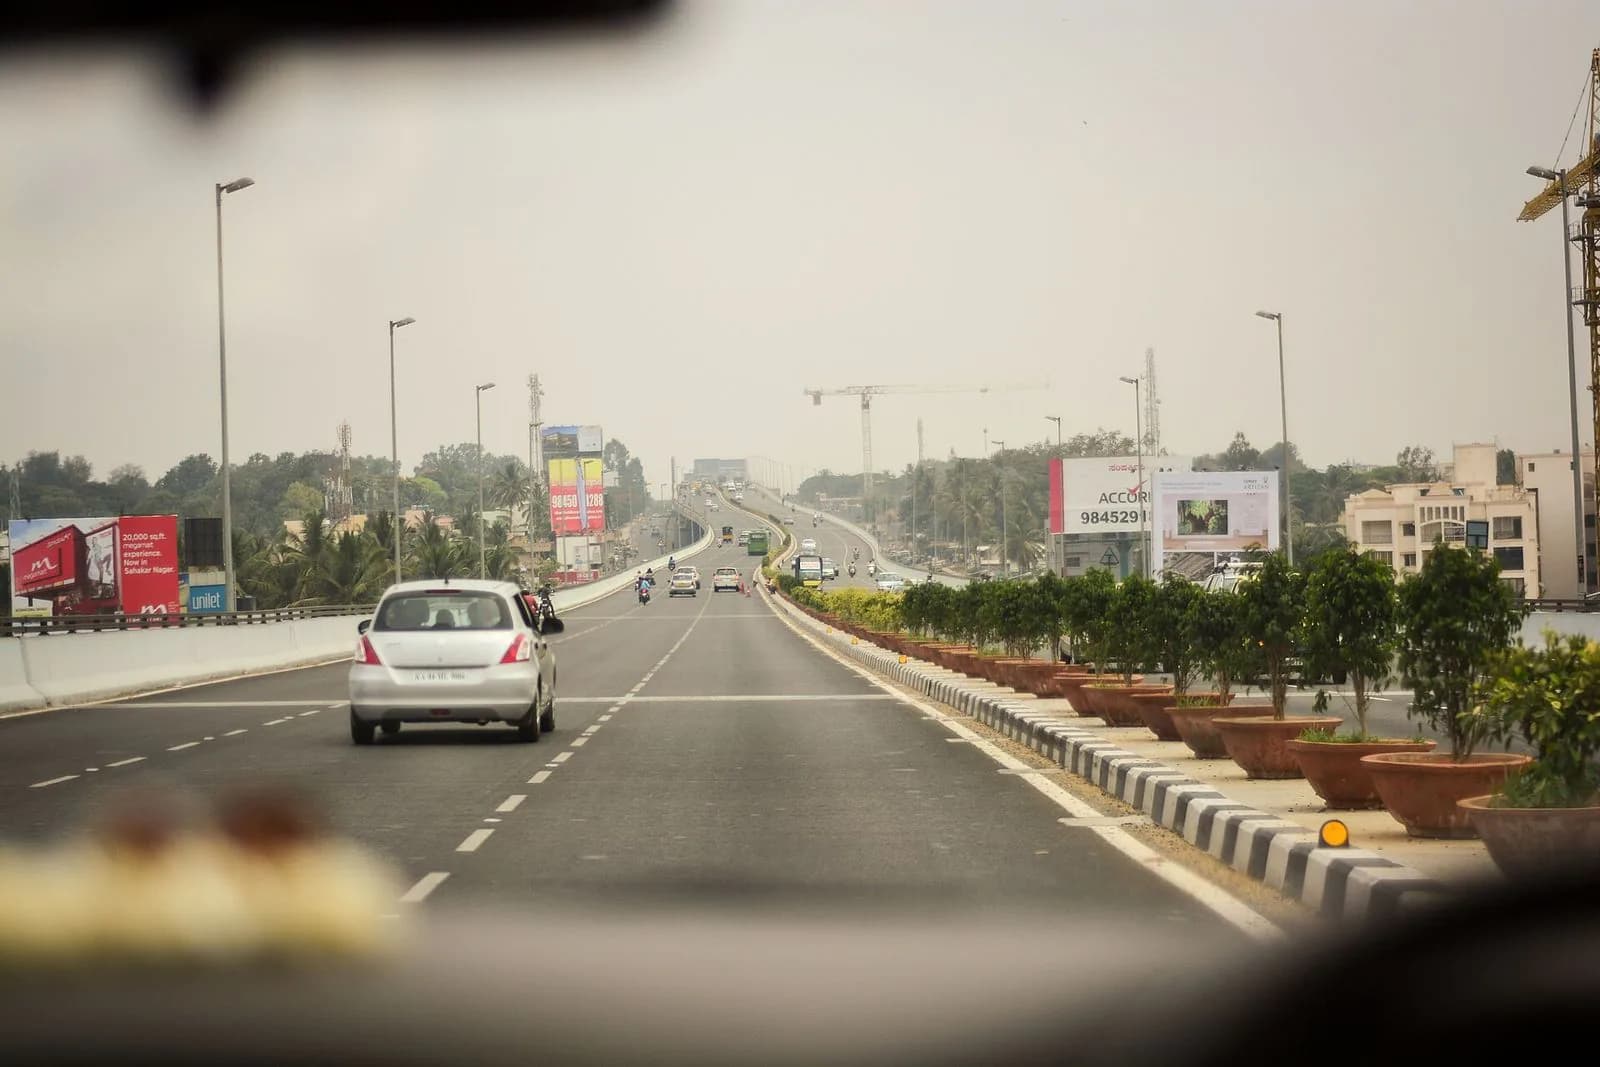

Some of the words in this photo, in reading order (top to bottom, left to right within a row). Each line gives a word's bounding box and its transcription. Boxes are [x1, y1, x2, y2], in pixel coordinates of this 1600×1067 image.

[1080, 510, 1151, 524] 9845291
[122, 533, 148, 542] 20,000
[123, 550, 162, 558] experience.
[140, 558, 148, 566] in
[124, 567, 152, 575] Sahakar
[192, 591, 220, 610] unilet
